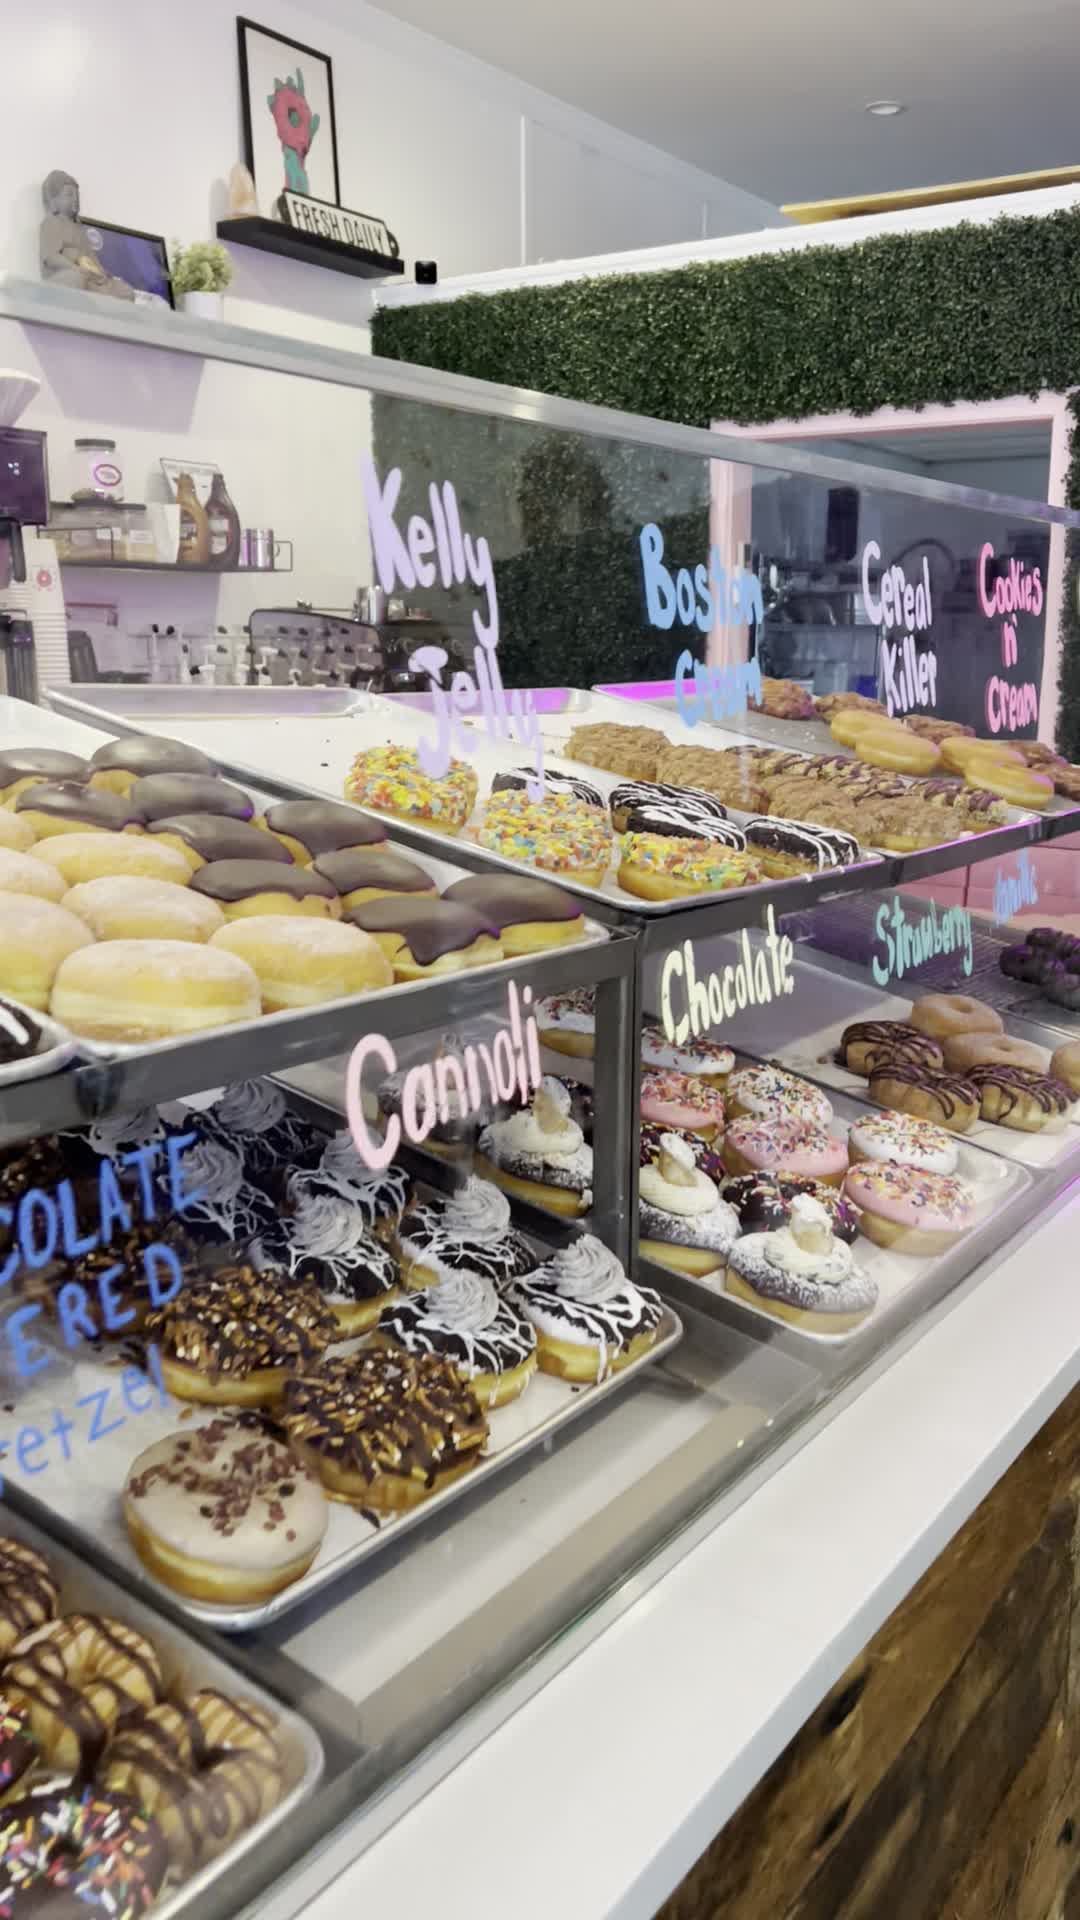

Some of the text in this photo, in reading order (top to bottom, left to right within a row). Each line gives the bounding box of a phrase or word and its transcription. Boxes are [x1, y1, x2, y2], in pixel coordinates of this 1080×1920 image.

[291, 200, 385, 255] FRESH DAILY
[361, 450, 499, 650] Kelly
[640, 523, 764, 632] Boston
[862, 540, 933, 631] Cereal
[978, 542, 1044, 618] Cookies
[408, 645, 545, 803] Jelly
[881, 634, 937, 718] Killer
[661, 903, 795, 1045] Chocolate
[873, 896, 973, 986] Strawberry
[346, 979, 542, 1170] Cannoli
[6, 1243, 183, 1378] ERED
